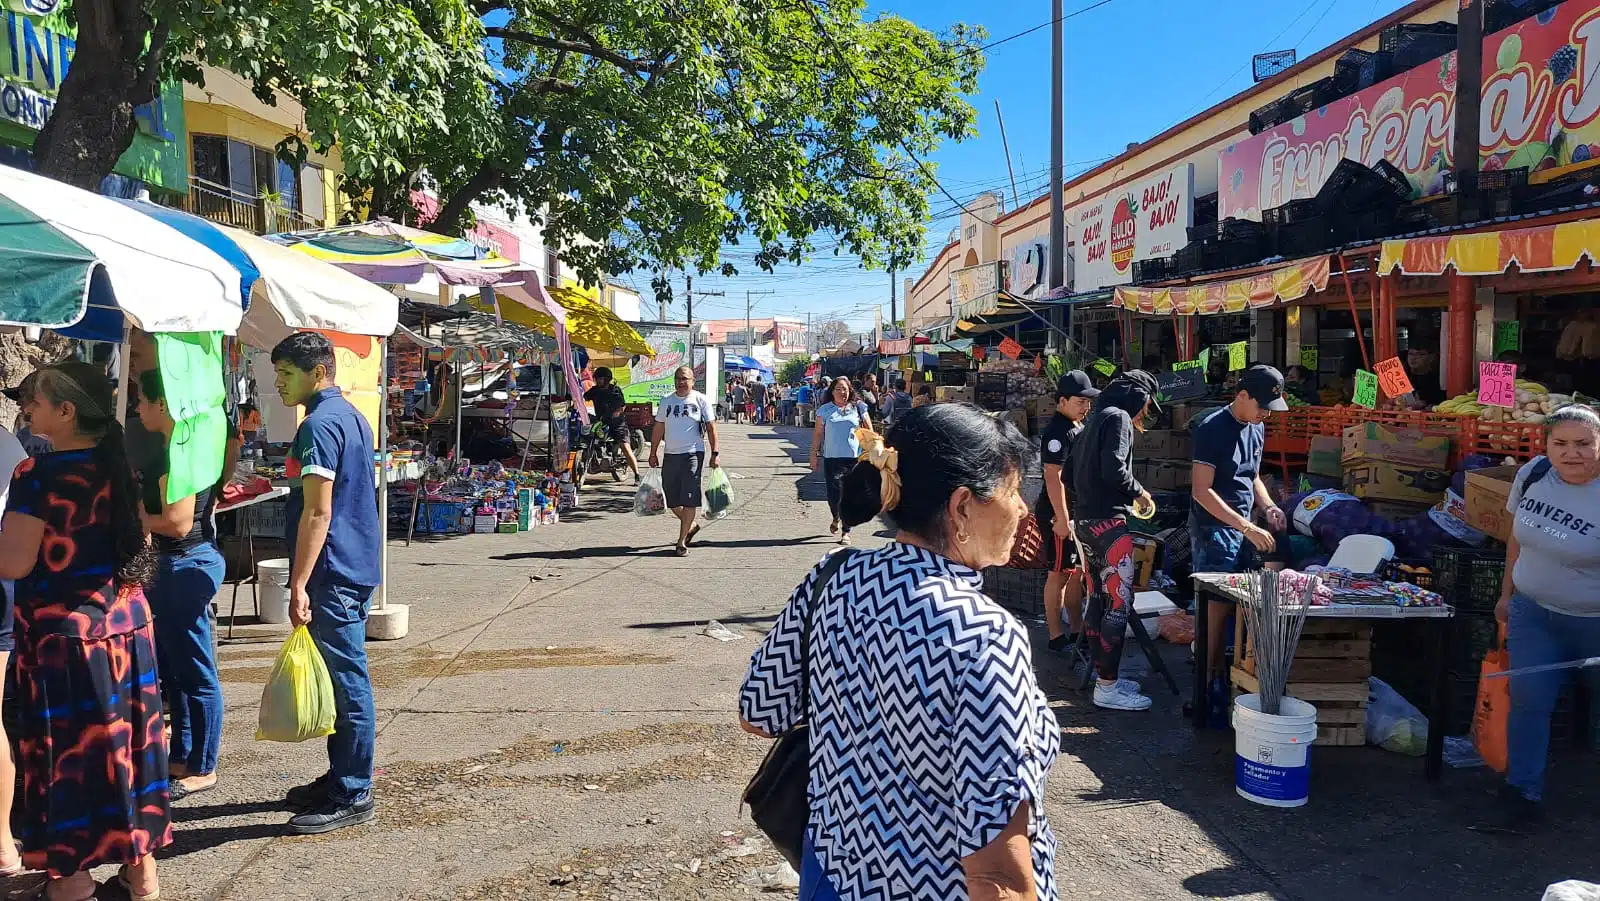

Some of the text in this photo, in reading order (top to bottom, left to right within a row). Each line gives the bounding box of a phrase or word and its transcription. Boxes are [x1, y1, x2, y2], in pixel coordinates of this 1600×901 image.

[1260, 66, 1552, 212] Frutera
[1142, 172, 1173, 212] BAJO!
[1149, 192, 1180, 231] BAJO!
[1520, 497, 1595, 536] CONVERSE
[1543, 526, 1568, 540] STAR
